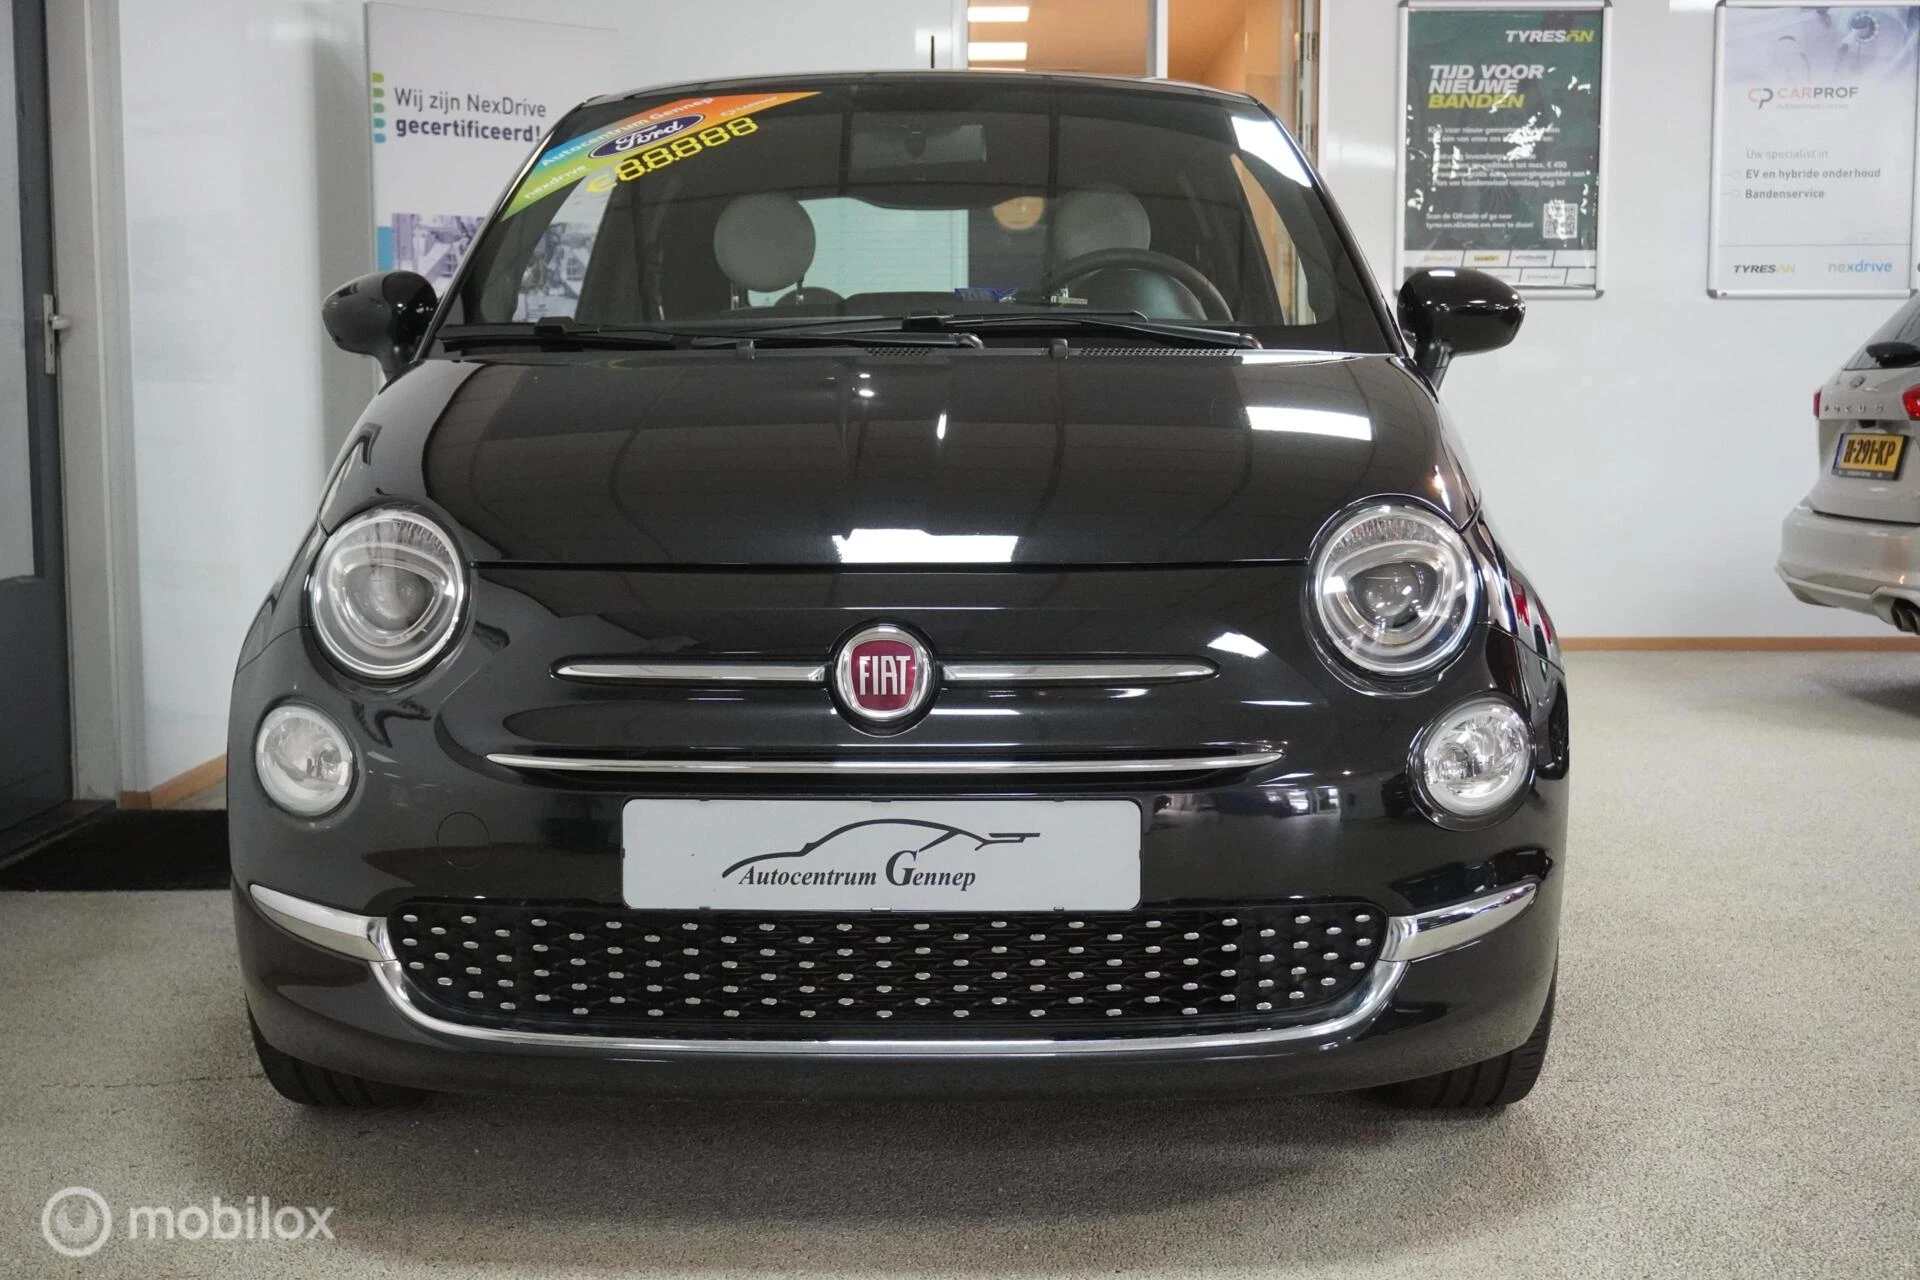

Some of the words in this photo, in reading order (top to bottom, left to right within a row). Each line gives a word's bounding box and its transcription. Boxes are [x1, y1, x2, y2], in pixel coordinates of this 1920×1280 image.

[1429, 64, 1475, 79] TIJD
[1481, 64, 1545, 79] VOOR
[1428, 79, 1520, 94] NIEUWE
[1777, 87, 1859, 99] CARPROF
[394, 87, 423, 112] Wij
[429, 91, 461, 115] zijn
[467, 94, 547, 118] NexDrive
[1428, 94, 1525, 109] BANDEN
[396, 118, 541, 142] gecertificeerd!
[542, 118, 648, 167] Autocentrum
[650, 97, 714, 120] Gennep
[614, 121, 684, 151] Ford
[1746, 150, 1762, 159] Uw
[1766, 150, 1816, 160] specialist
[524, 165, 587, 198] nexdrive
[1746, 169, 1760, 178] EV
[1762, 170, 1775, 178] en
[1778, 168, 1819, 181] hybride
[1822, 168, 1881, 178] onderhoud
[1745, 189, 1825, 199] Bandenservice
[1828, 259, 1893, 273] nexdrive
[859, 656, 911, 695] FIAT
[738, 865, 877, 886] Autocentrum
[884, 849, 976, 891] Gennep
